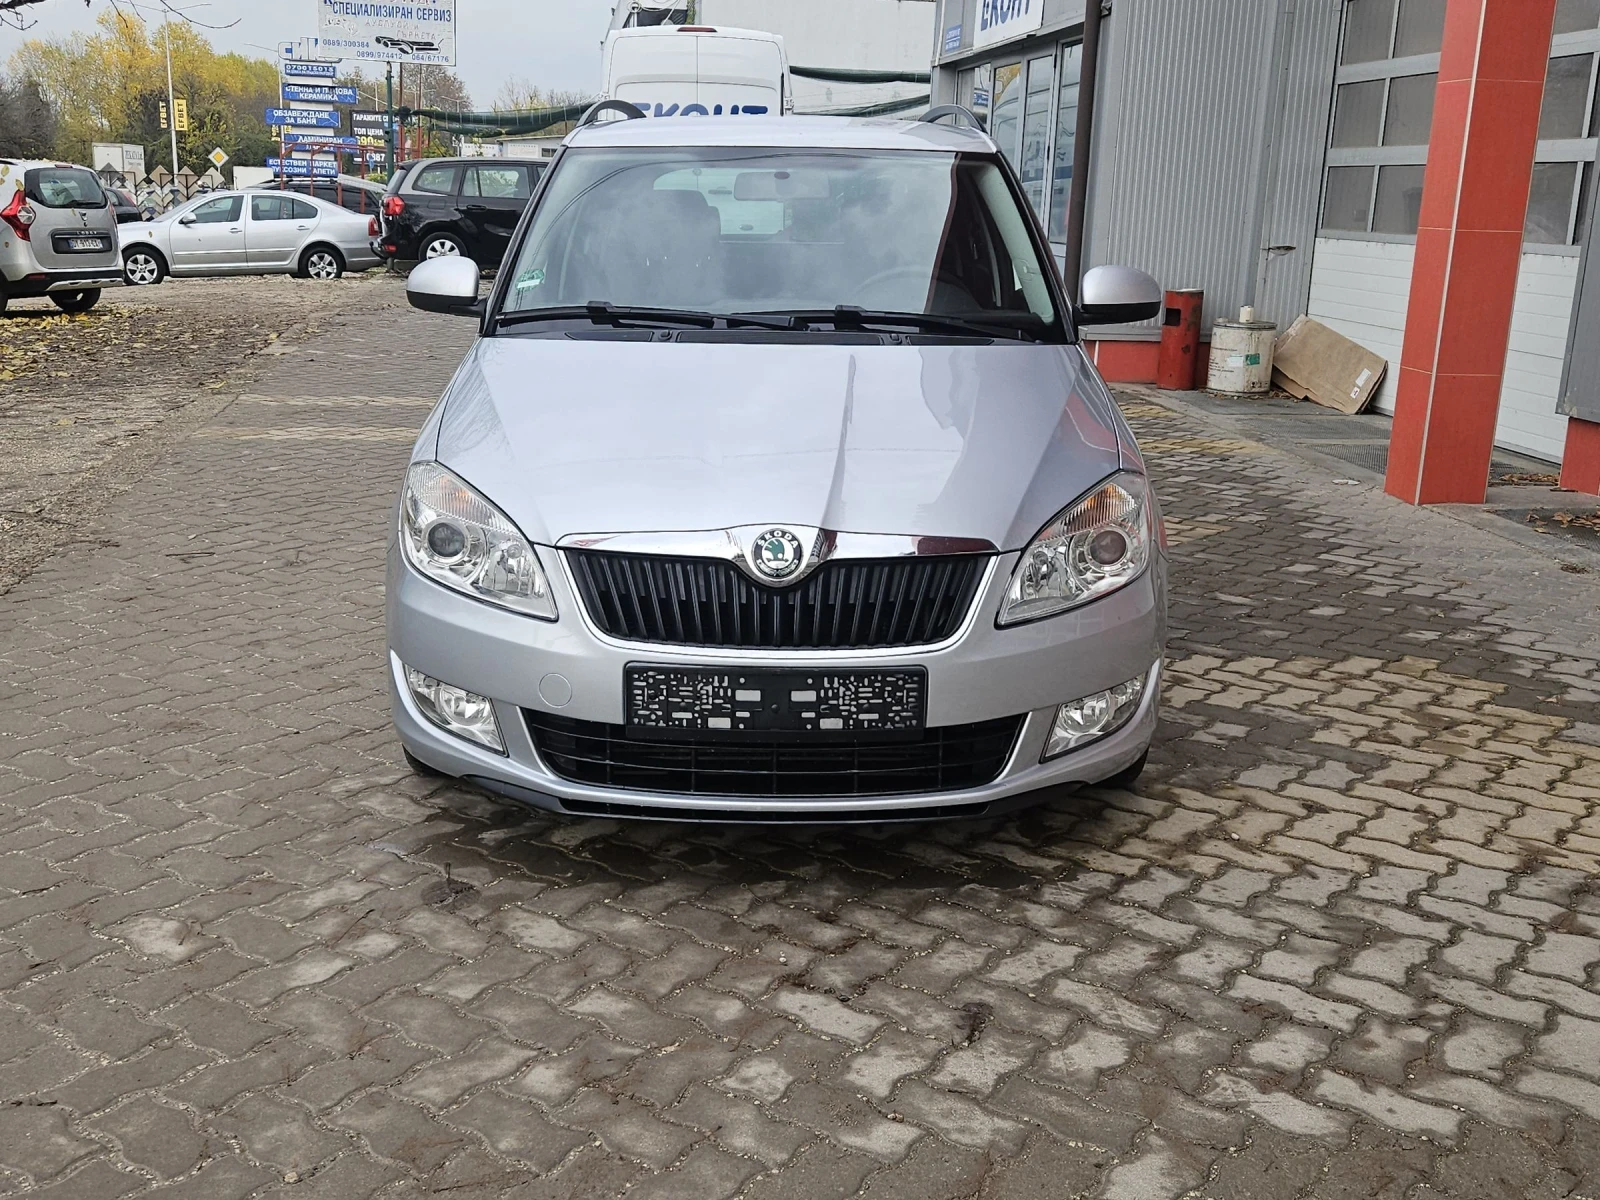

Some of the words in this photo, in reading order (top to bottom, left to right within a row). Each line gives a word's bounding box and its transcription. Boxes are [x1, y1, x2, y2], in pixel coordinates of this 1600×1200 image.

[333, 2, 413, 19] СПЕЦИАЛИЗИРАН
[416, 8, 452, 22] СЕРВИЗ
[323, 39, 369, 48] 0889/300384
[357, 51, 403, 59] 0899/974412
[285, 86, 313, 94] СТЕННА
[299, 93, 338, 101] КЕРАМИКА
[177, 102, 185, 129] EFBET
[273, 110, 329, 119] ОБЗАВЕЖДАНЕ
[296, 117, 317, 125] БАНЯ
[353, 127, 366, 135] ТОП
[367, 127, 384, 137] ЦЕНА
